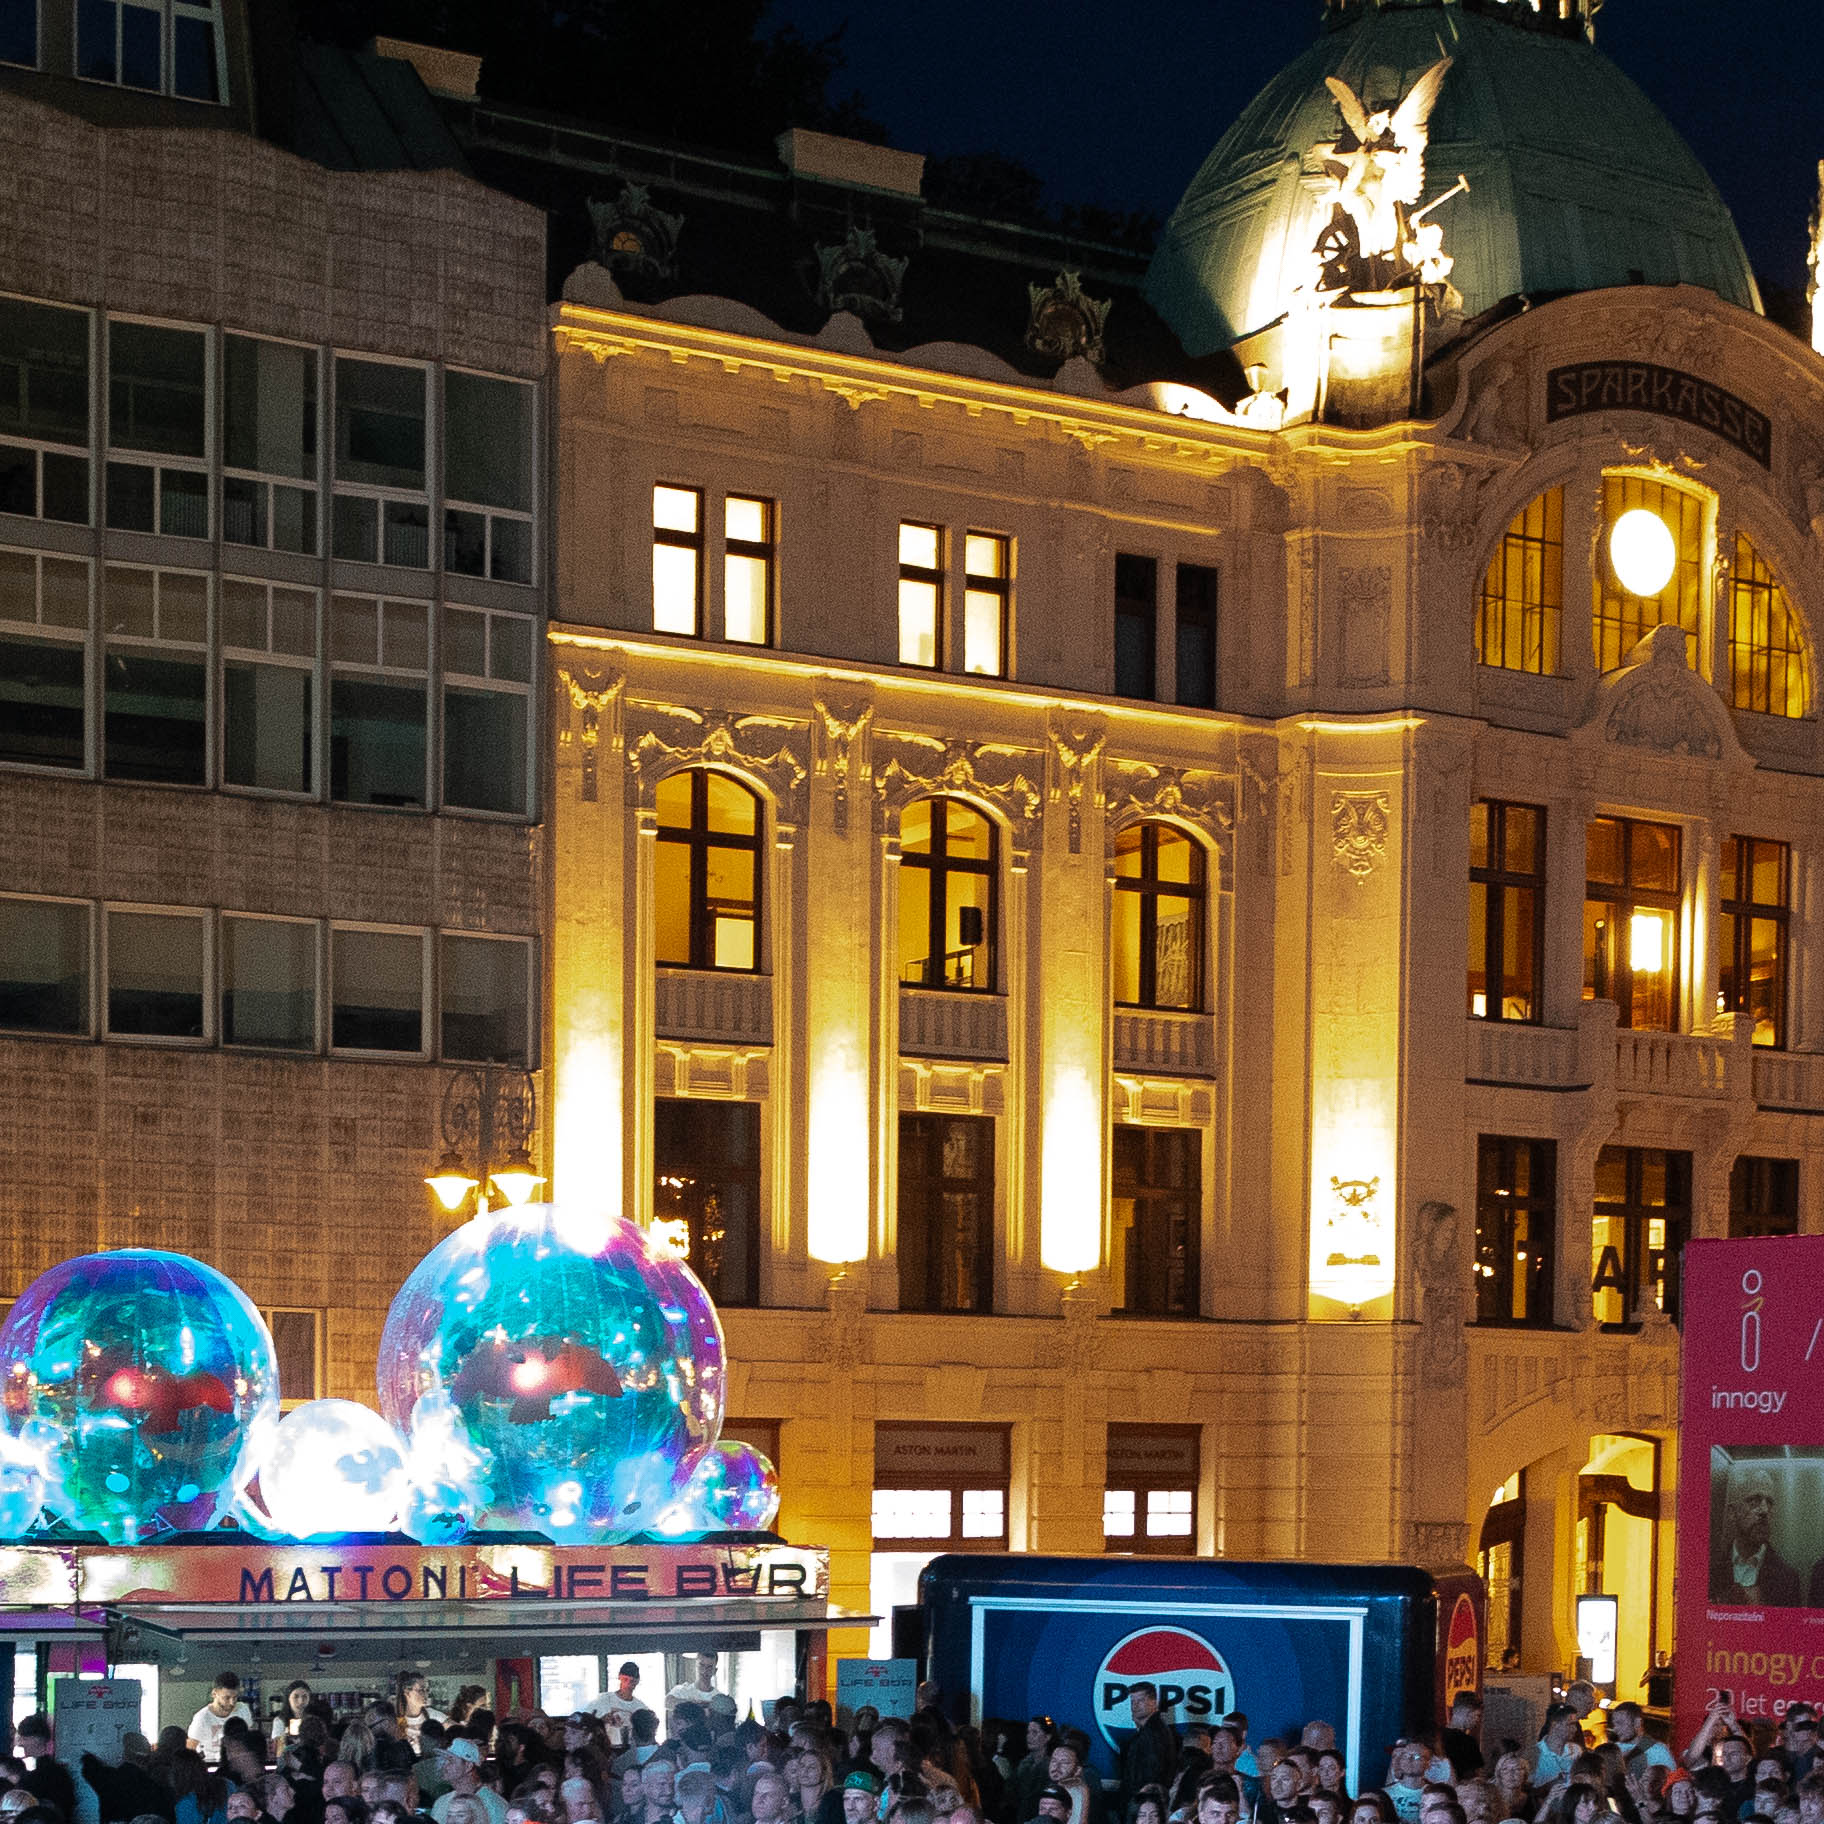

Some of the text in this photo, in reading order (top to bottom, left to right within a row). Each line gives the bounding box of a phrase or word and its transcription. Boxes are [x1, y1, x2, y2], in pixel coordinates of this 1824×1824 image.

[1557, 366, 1765, 455] SPARKASSE
[1710, 1385, 1788, 1415] innogy
[239, 1563, 467, 1603] MATTONI
[508, 1564, 649, 1600] LIFE
[1447, 1655, 1476, 1689] PEPSI
[1102, 1682, 1226, 1715] PPSI
[1739, 1690, 1767, 1715] let
